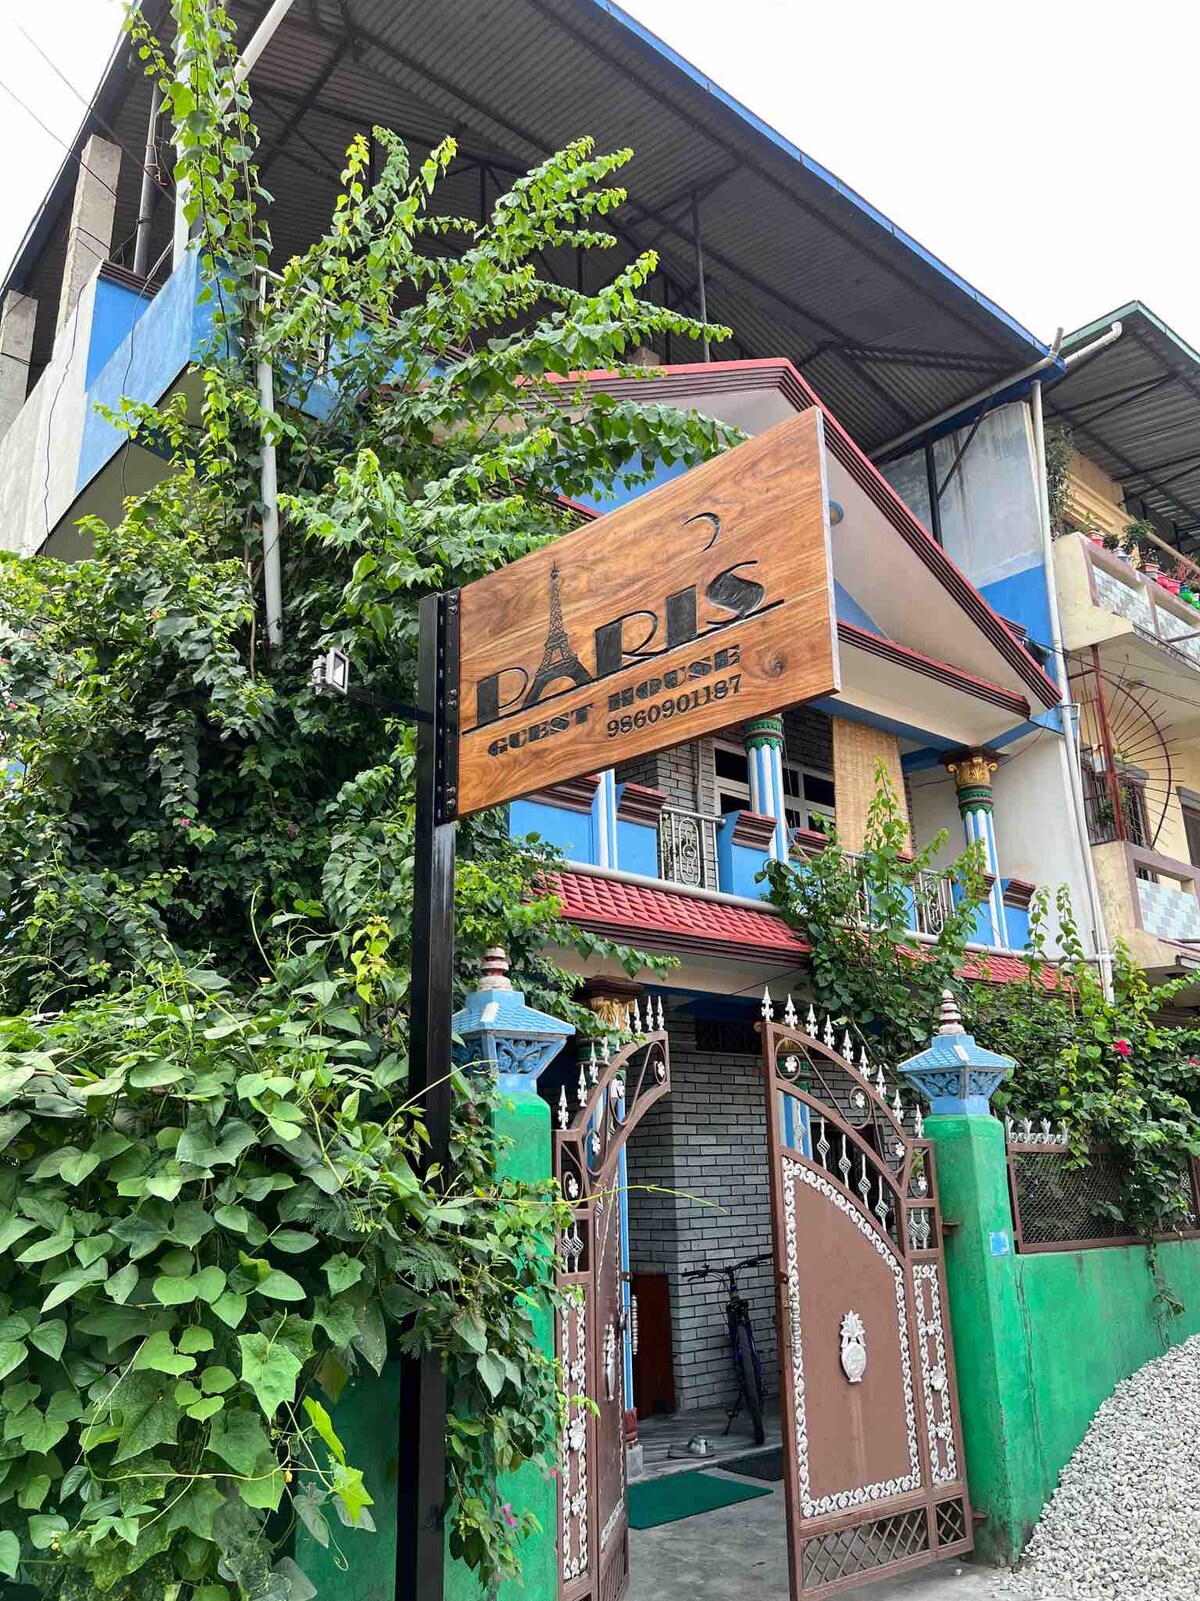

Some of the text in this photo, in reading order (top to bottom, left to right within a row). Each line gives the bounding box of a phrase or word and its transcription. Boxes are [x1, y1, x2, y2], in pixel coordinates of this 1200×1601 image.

[476, 560, 765, 727] PARIS
[487, 645, 741, 757] GUEST HOUSE
[607, 674, 742, 738] 9860901187
